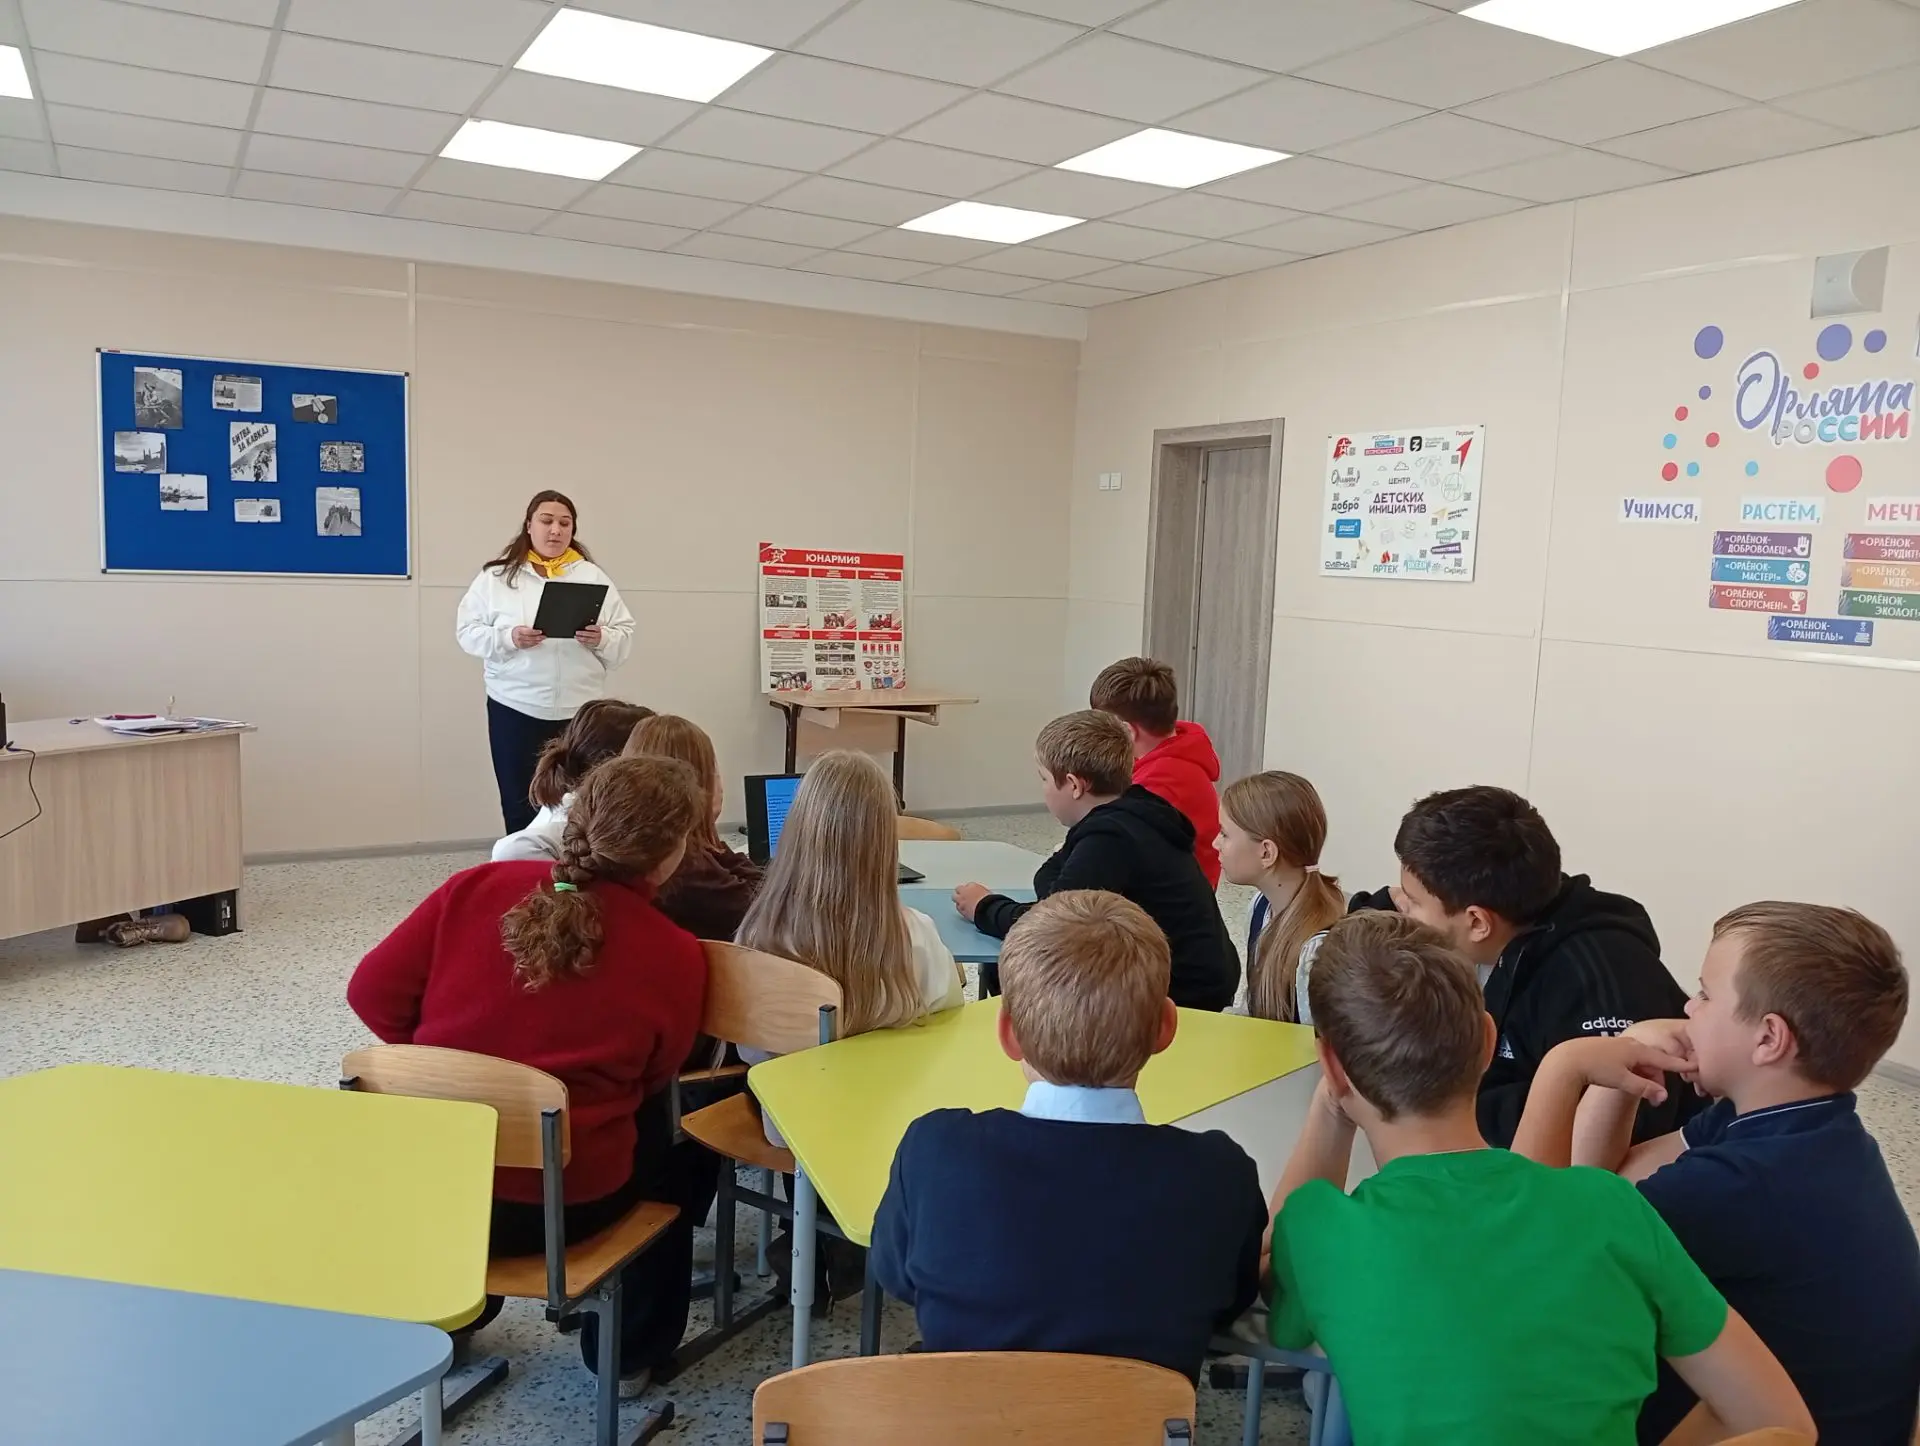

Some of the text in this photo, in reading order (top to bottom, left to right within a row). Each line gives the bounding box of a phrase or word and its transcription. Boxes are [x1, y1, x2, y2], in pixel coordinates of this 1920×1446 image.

[1736, 351, 1914, 437] Орлята
[1774, 411, 1909, 445] РОССИИ
[231, 426, 251, 446] БИТВА
[237, 424, 269, 452] ЗА КАВКАЗ
[1388, 477, 1411, 485] ЦЕНТР
[1373, 492, 1424, 503] ДЕТСКИХ
[1368, 504, 1427, 514] ИНИЦИАТИВ
[1742, 501, 1821, 523] РАСТЁМ,
[805, 553, 861, 565] ЮНАРМИЯ
[1373, 564, 1398, 573] АРТЕК
[1582, 1016, 1634, 1030] adidas
